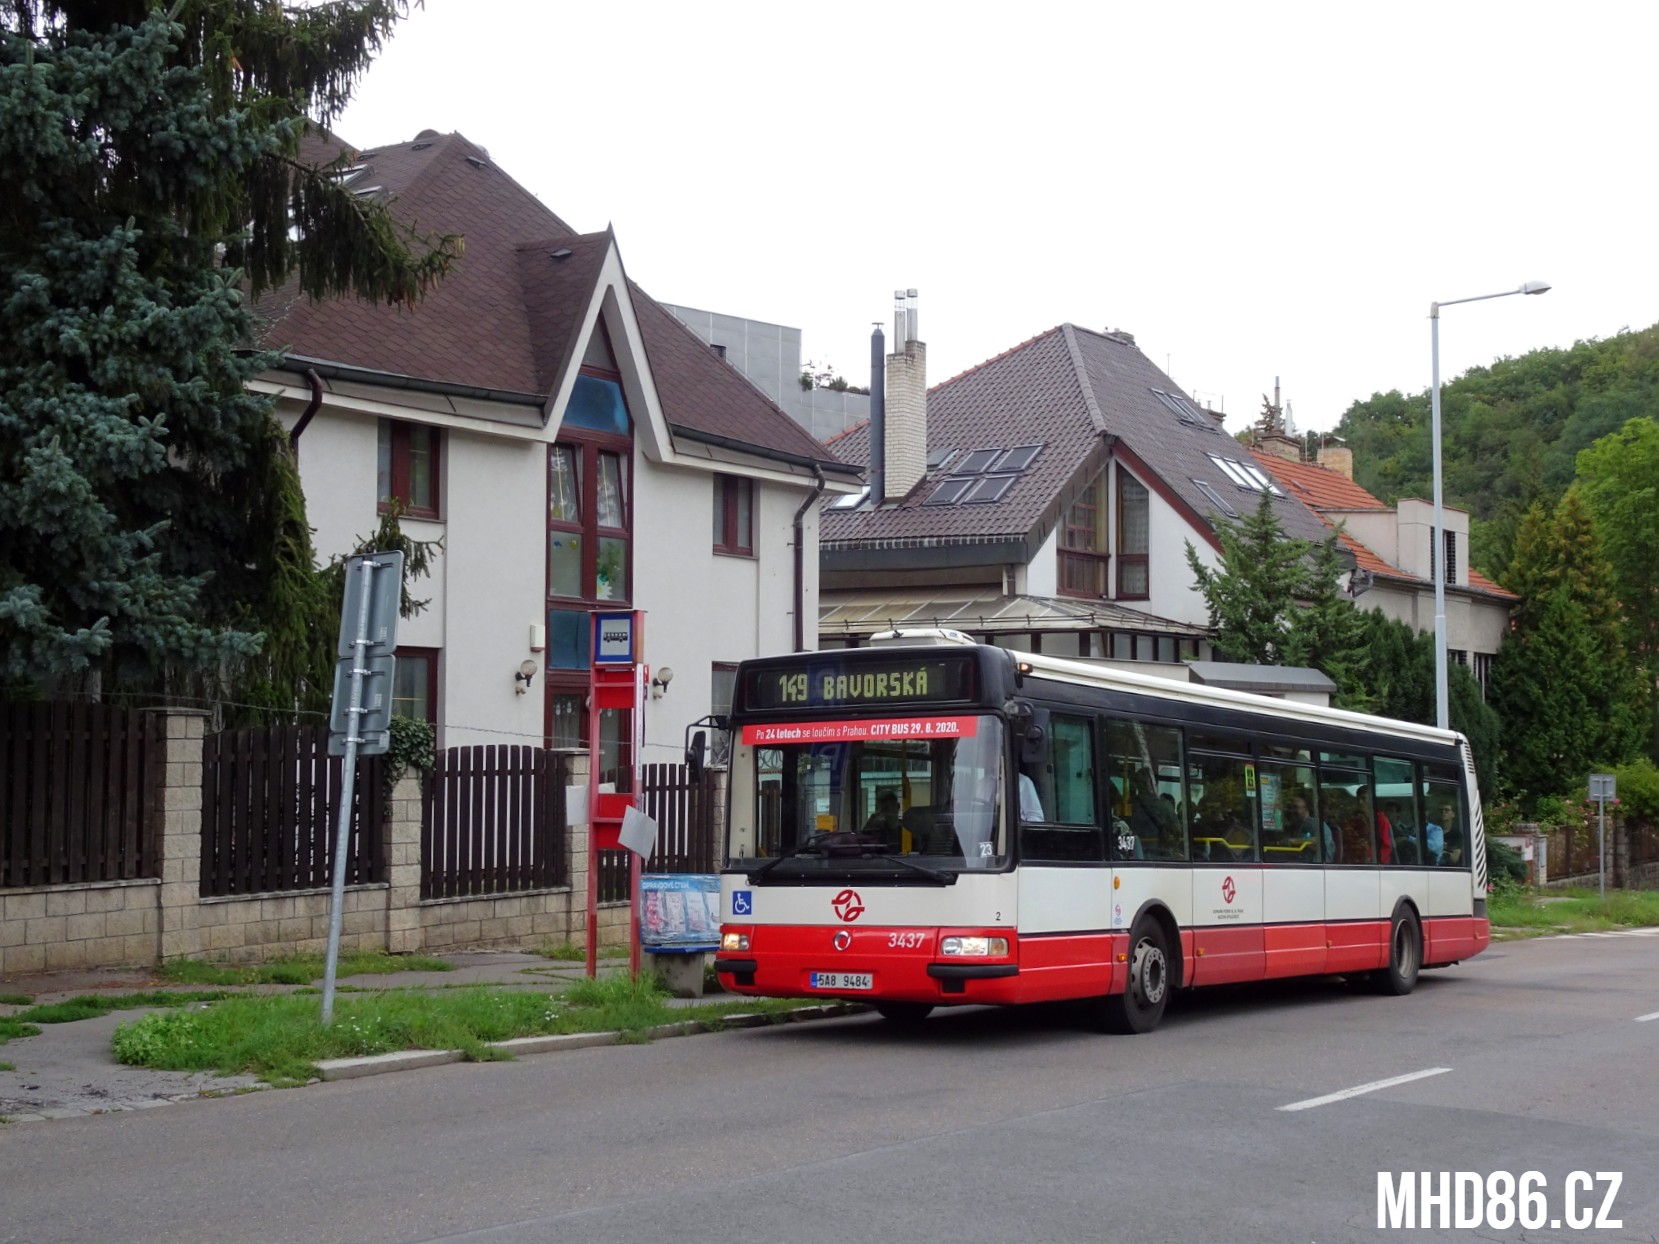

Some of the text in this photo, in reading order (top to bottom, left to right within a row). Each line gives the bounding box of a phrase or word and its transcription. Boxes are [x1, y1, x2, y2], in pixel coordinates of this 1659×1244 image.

[779, 667, 928, 702] 149 BAVORSKÁ
[756, 721, 960, 740] Po 24 letech se loučím s Prahou. CITY BUS 29. 8. 2020.
[979, 843, 993, 858] 23
[1118, 835, 1135, 851] 3437
[995, 911, 1002, 921] 2
[888, 932, 925, 948] 3437
[818, 974, 868, 987] 5A8 9484
